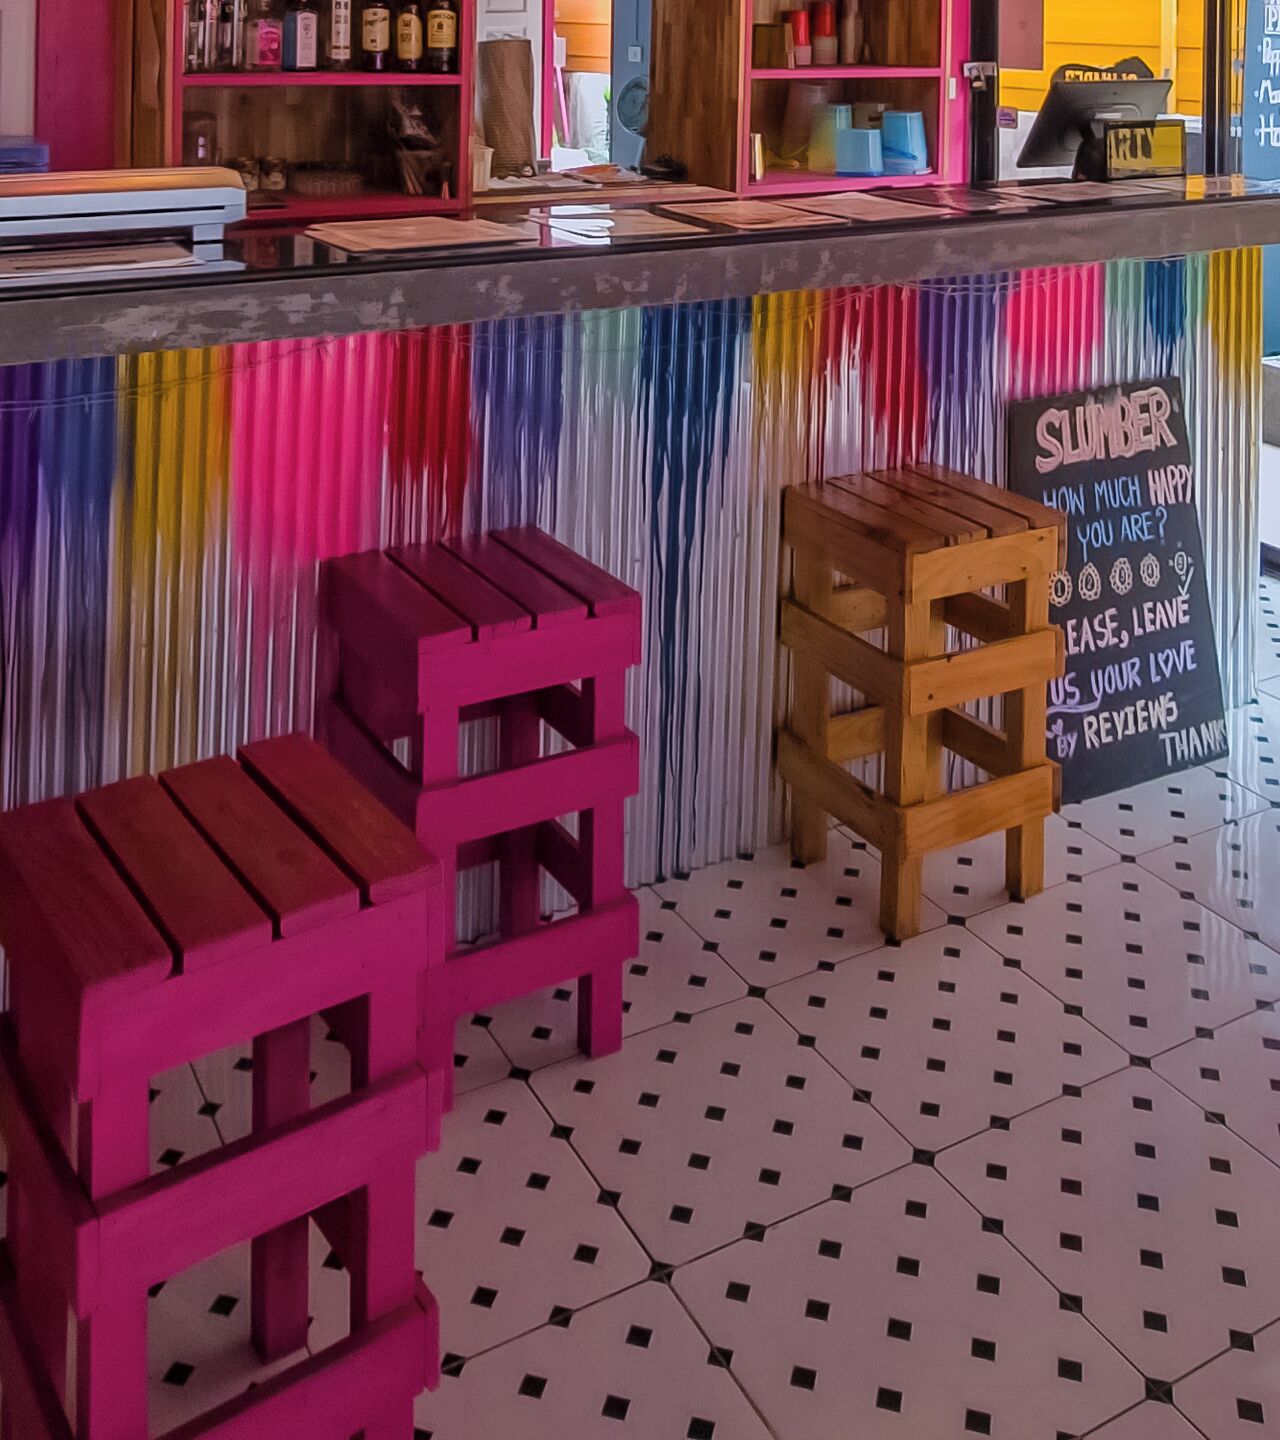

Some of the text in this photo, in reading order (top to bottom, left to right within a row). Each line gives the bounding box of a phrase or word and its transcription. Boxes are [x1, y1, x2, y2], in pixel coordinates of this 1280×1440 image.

[1035, 386, 1177, 474] SLUMBER
[1043, 464, 1193, 516] HOW MUCH HAPPY
[1076, 506, 1167, 563] YOU ARE?
[1132, 594, 1190, 636] LEAVE
[1050, 640, 1197, 706] US YOUR LOVE
[1083, 692, 1179, 750] REVIEWS
